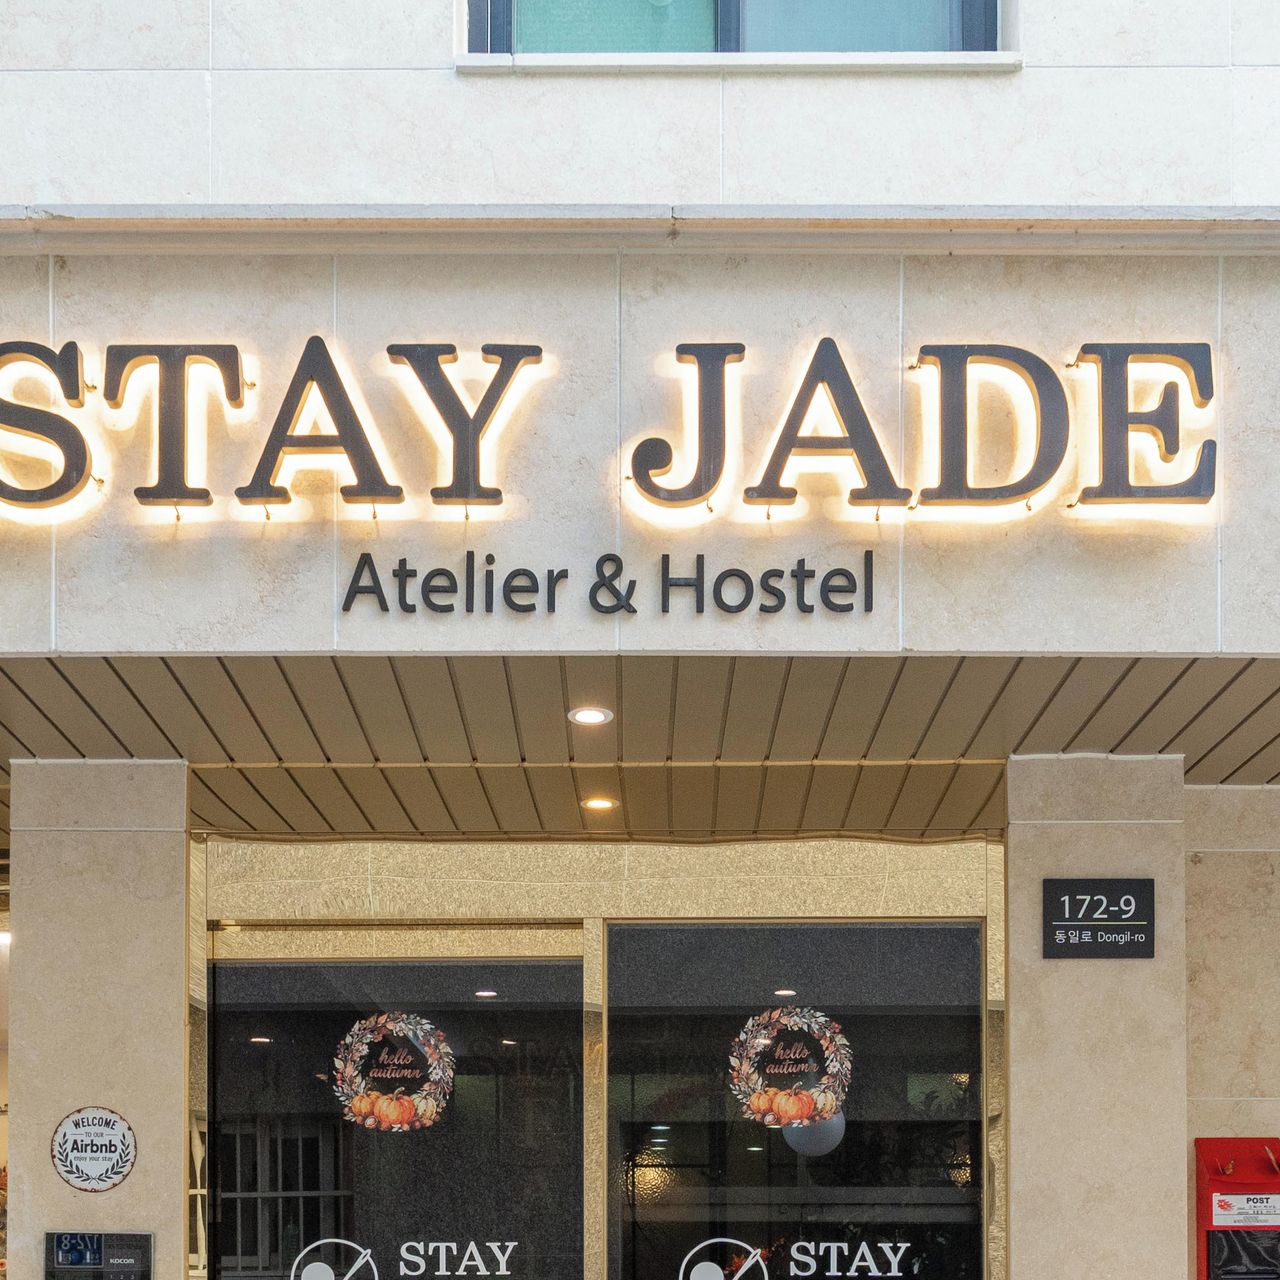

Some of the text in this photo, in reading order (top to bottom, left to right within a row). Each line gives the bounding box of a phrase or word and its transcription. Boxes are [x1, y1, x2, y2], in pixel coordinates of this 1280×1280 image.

[628, 336, 1217, 510] JADE
[341, 551, 875, 616] Atelier & Hostel
[1060, 895, 1136, 919] 172-9
[1054, 930, 1146, 945] 동일로 Dongil-ro
[378, 1047, 414, 1065] hello
[774, 1042, 810, 1060] hello
[368, 1065, 423, 1080] autumn
[765, 1060, 820, 1075] autumn
[72, 1116, 118, 1130] WELCOME
[70, 1139, 118, 1154] Airbnb
[399, 1241, 518, 1276] STAY
[789, 1241, 911, 1278] STAY
